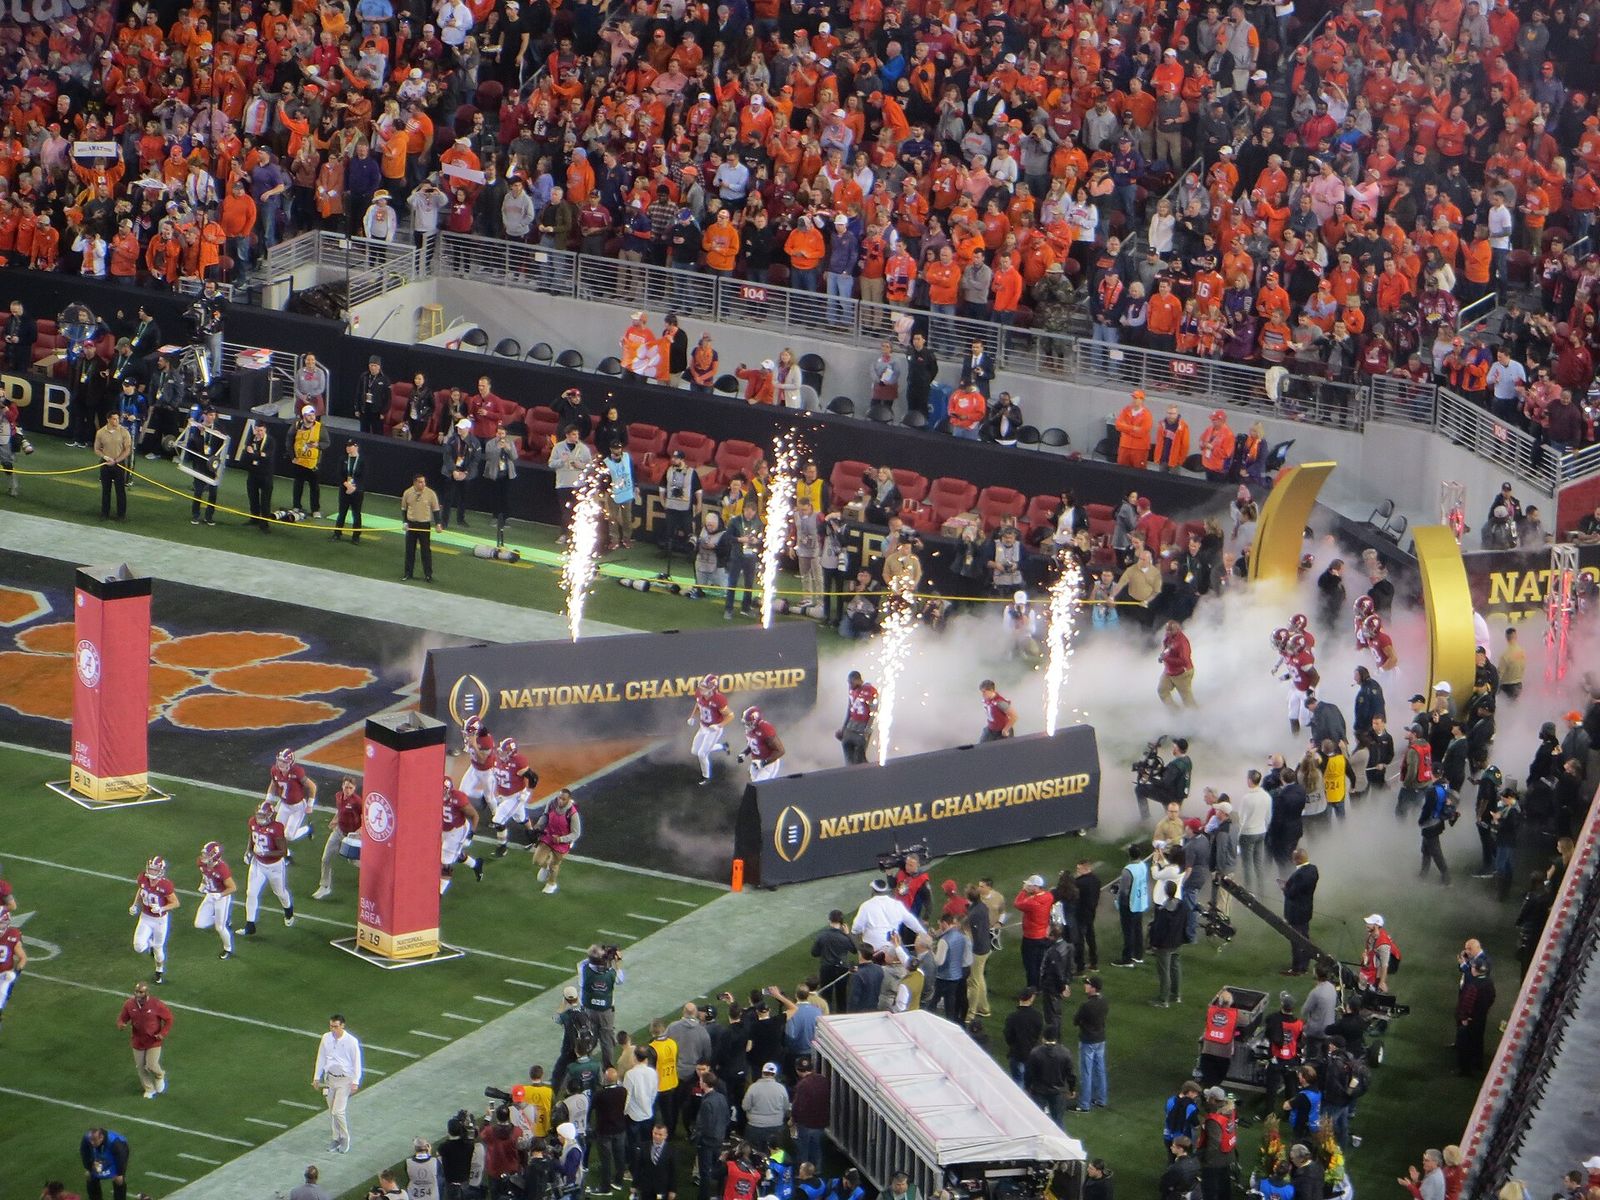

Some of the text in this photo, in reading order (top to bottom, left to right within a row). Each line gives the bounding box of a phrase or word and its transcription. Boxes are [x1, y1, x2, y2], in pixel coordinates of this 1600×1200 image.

[743, 287, 765, 301] 104
[1198, 281, 1210, 298] 16
[1172, 361, 1194, 374] 105
[500, 668, 806, 710] NATIONAL CHAMONSHIP
[819, 773, 1090, 840] NATIONAL CHAMPIONSHIP
[360, 897, 375, 911] BAY
[360, 909, 382, 926] AREA
[413, 1187, 432, 1198] 254
